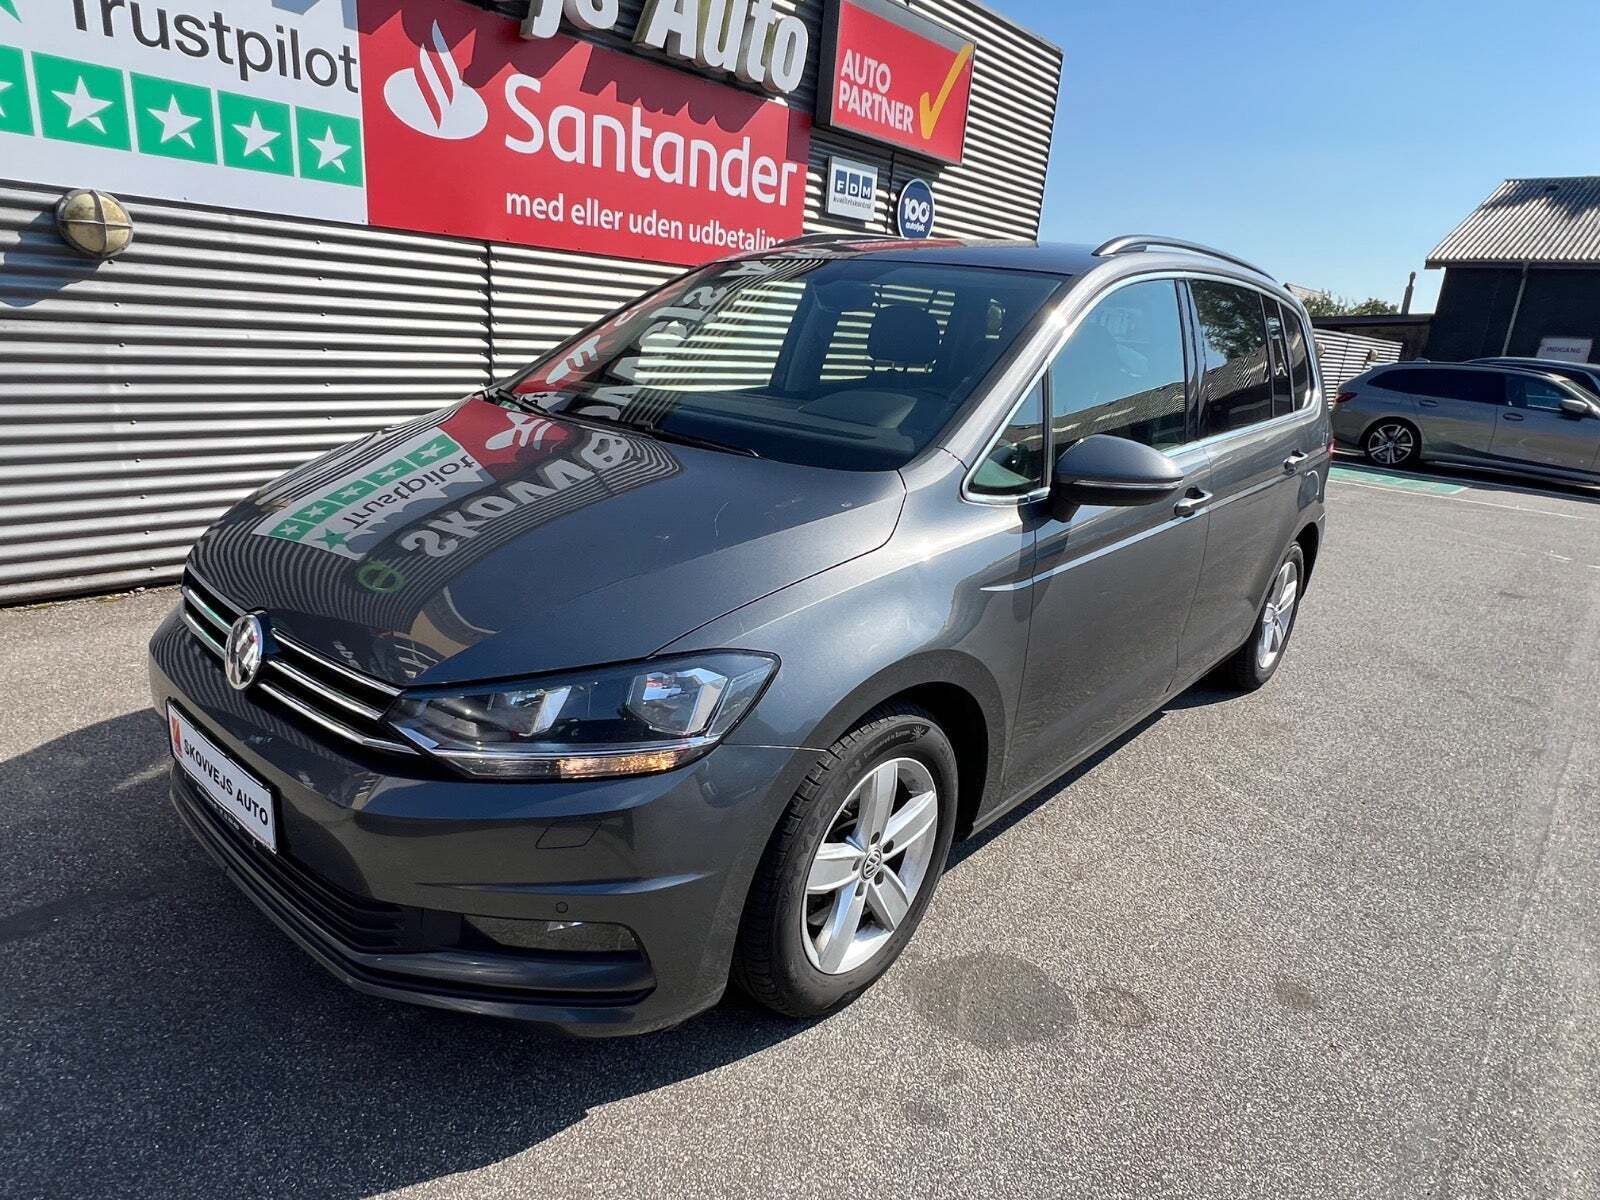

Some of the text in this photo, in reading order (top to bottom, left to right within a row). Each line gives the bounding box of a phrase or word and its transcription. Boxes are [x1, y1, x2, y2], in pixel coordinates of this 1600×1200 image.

[840, 49, 891, 94] AUTO
[838, 80, 914, 134] PARTNER
[504, 73, 798, 207] Santander
[836, 180, 872, 199] FDM
[506, 191, 565, 222] med
[570, 198, 624, 232] eller
[629, 212, 683, 241] uden
[184, 739, 234, 796] SKOVVEJS
[236, 787, 269, 826] AUTO
